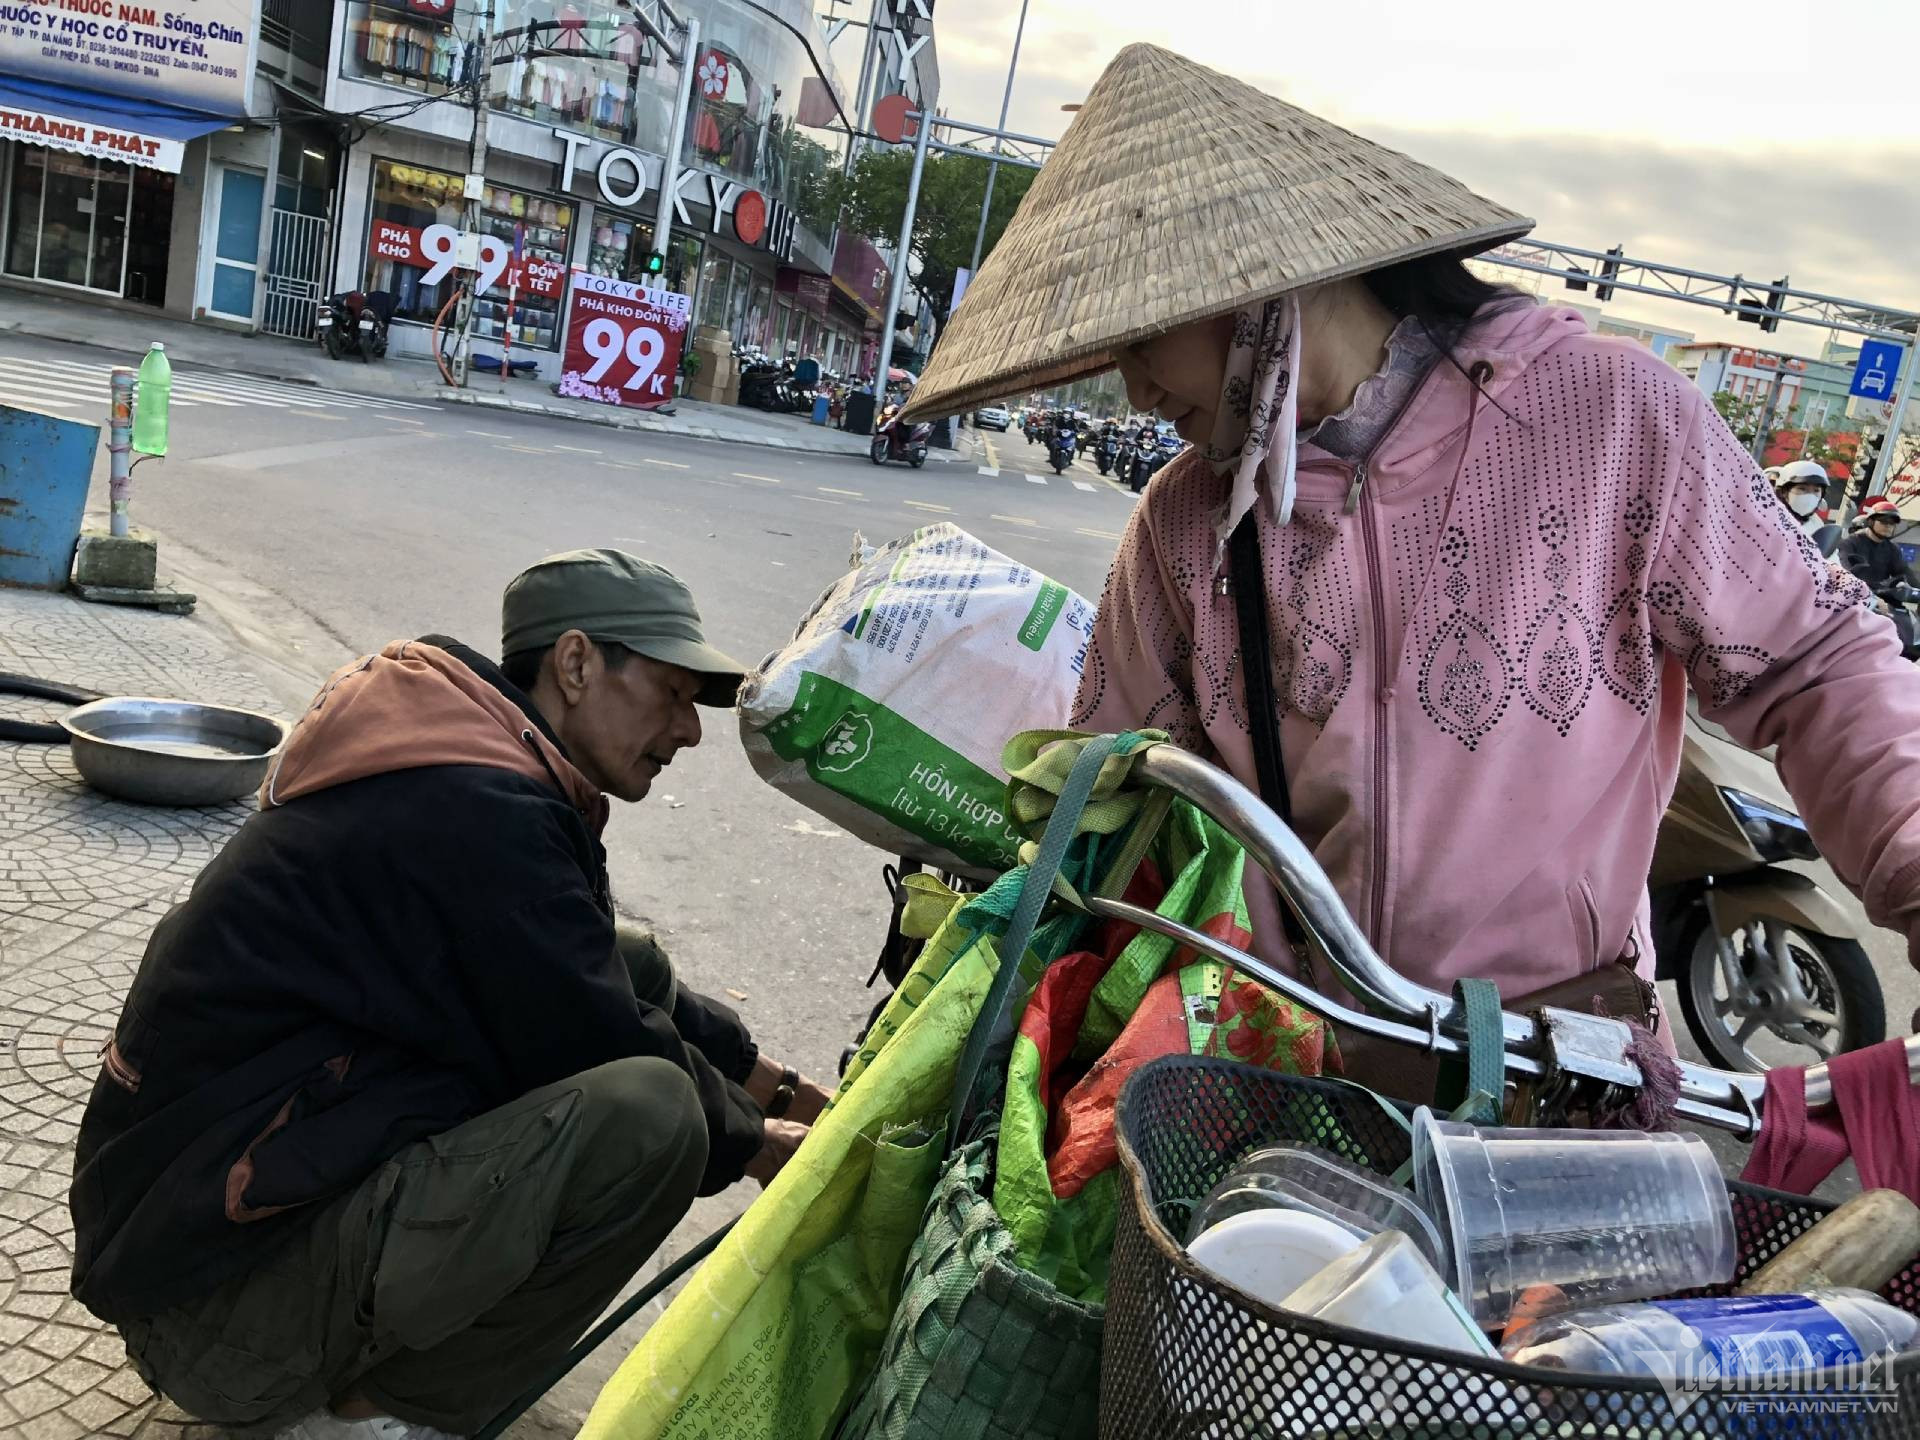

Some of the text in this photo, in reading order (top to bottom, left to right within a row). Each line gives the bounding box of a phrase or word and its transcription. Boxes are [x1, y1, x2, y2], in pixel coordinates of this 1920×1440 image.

[46, 13, 57, 28] Y
[61, 17, 99, 39] HỌC
[103, 21, 129, 42] CỔ
[119, 4, 160, 27] NAM.
[0, 111, 85, 142] THÀNH
[381, 227, 411, 245] PHÁ
[377, 242, 410, 258] KHO
[579, 297, 604, 311] PHÁ
[606, 302, 633, 317] KHO
[909, 762, 1004, 828] HỖN HỢP
[924, 807, 949, 832] 13
[694, 1388, 722, 1417] TNHH
[720, 1371, 738, 1389] TM
[735, 1351, 756, 1373] Kim
[732, 1371, 775, 1421] Polyester
[718, 1386, 743, 1415] KCN
[760, 1395, 774, 1414] 38
